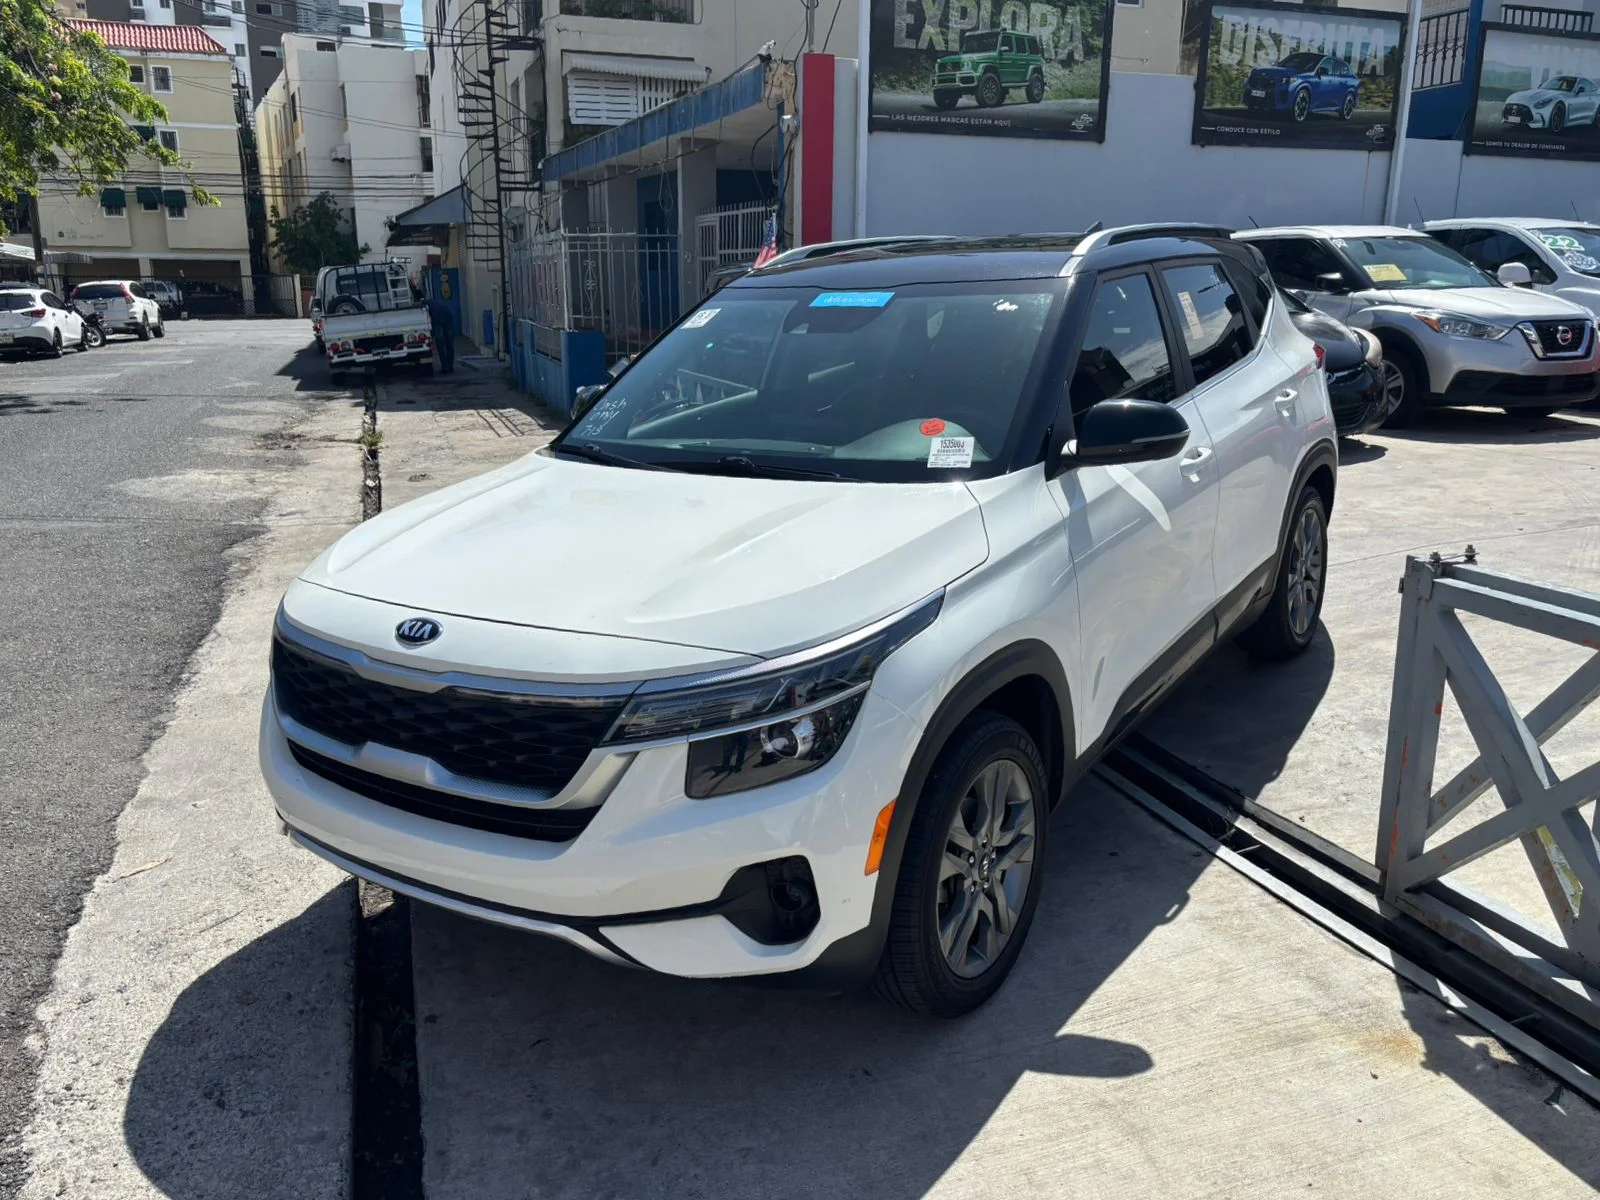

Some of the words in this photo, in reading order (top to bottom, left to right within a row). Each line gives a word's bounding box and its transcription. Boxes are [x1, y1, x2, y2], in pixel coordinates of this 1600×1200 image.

[893, 0, 1085, 62] EXPLORA
[1219, 14, 1385, 76] DISFRUTA
[891, 113, 905, 121] LAS
[907, 114, 939, 122] MEJORES
[941, 116, 969, 125] MARCAS
[399, 620, 433, 639] KIA
